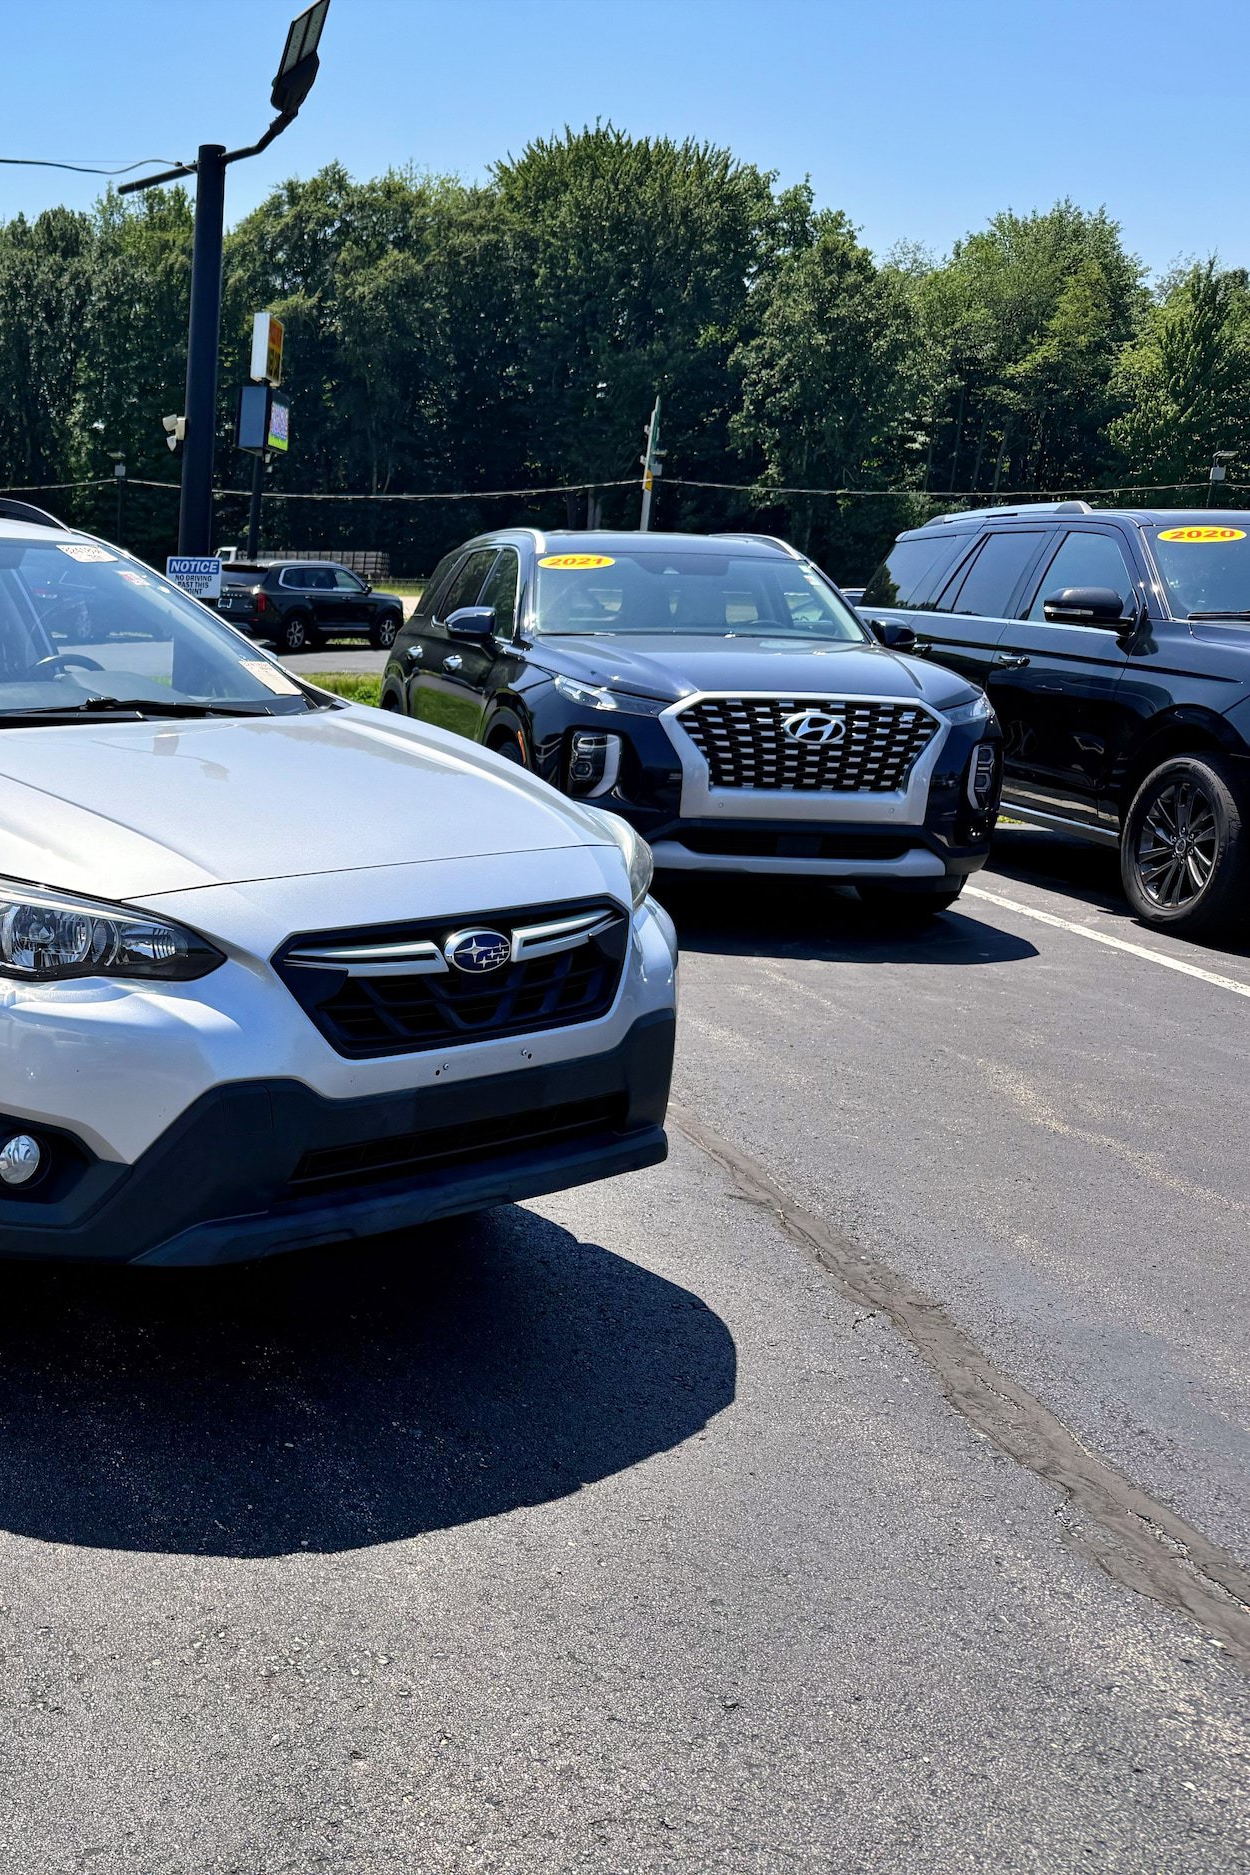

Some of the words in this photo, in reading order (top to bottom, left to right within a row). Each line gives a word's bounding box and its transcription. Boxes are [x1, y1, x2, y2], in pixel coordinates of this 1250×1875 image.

[1169, 530, 1236, 539] 2020
[170, 561, 218, 572] NOTICE
[548, 558, 603, 566] 2021
